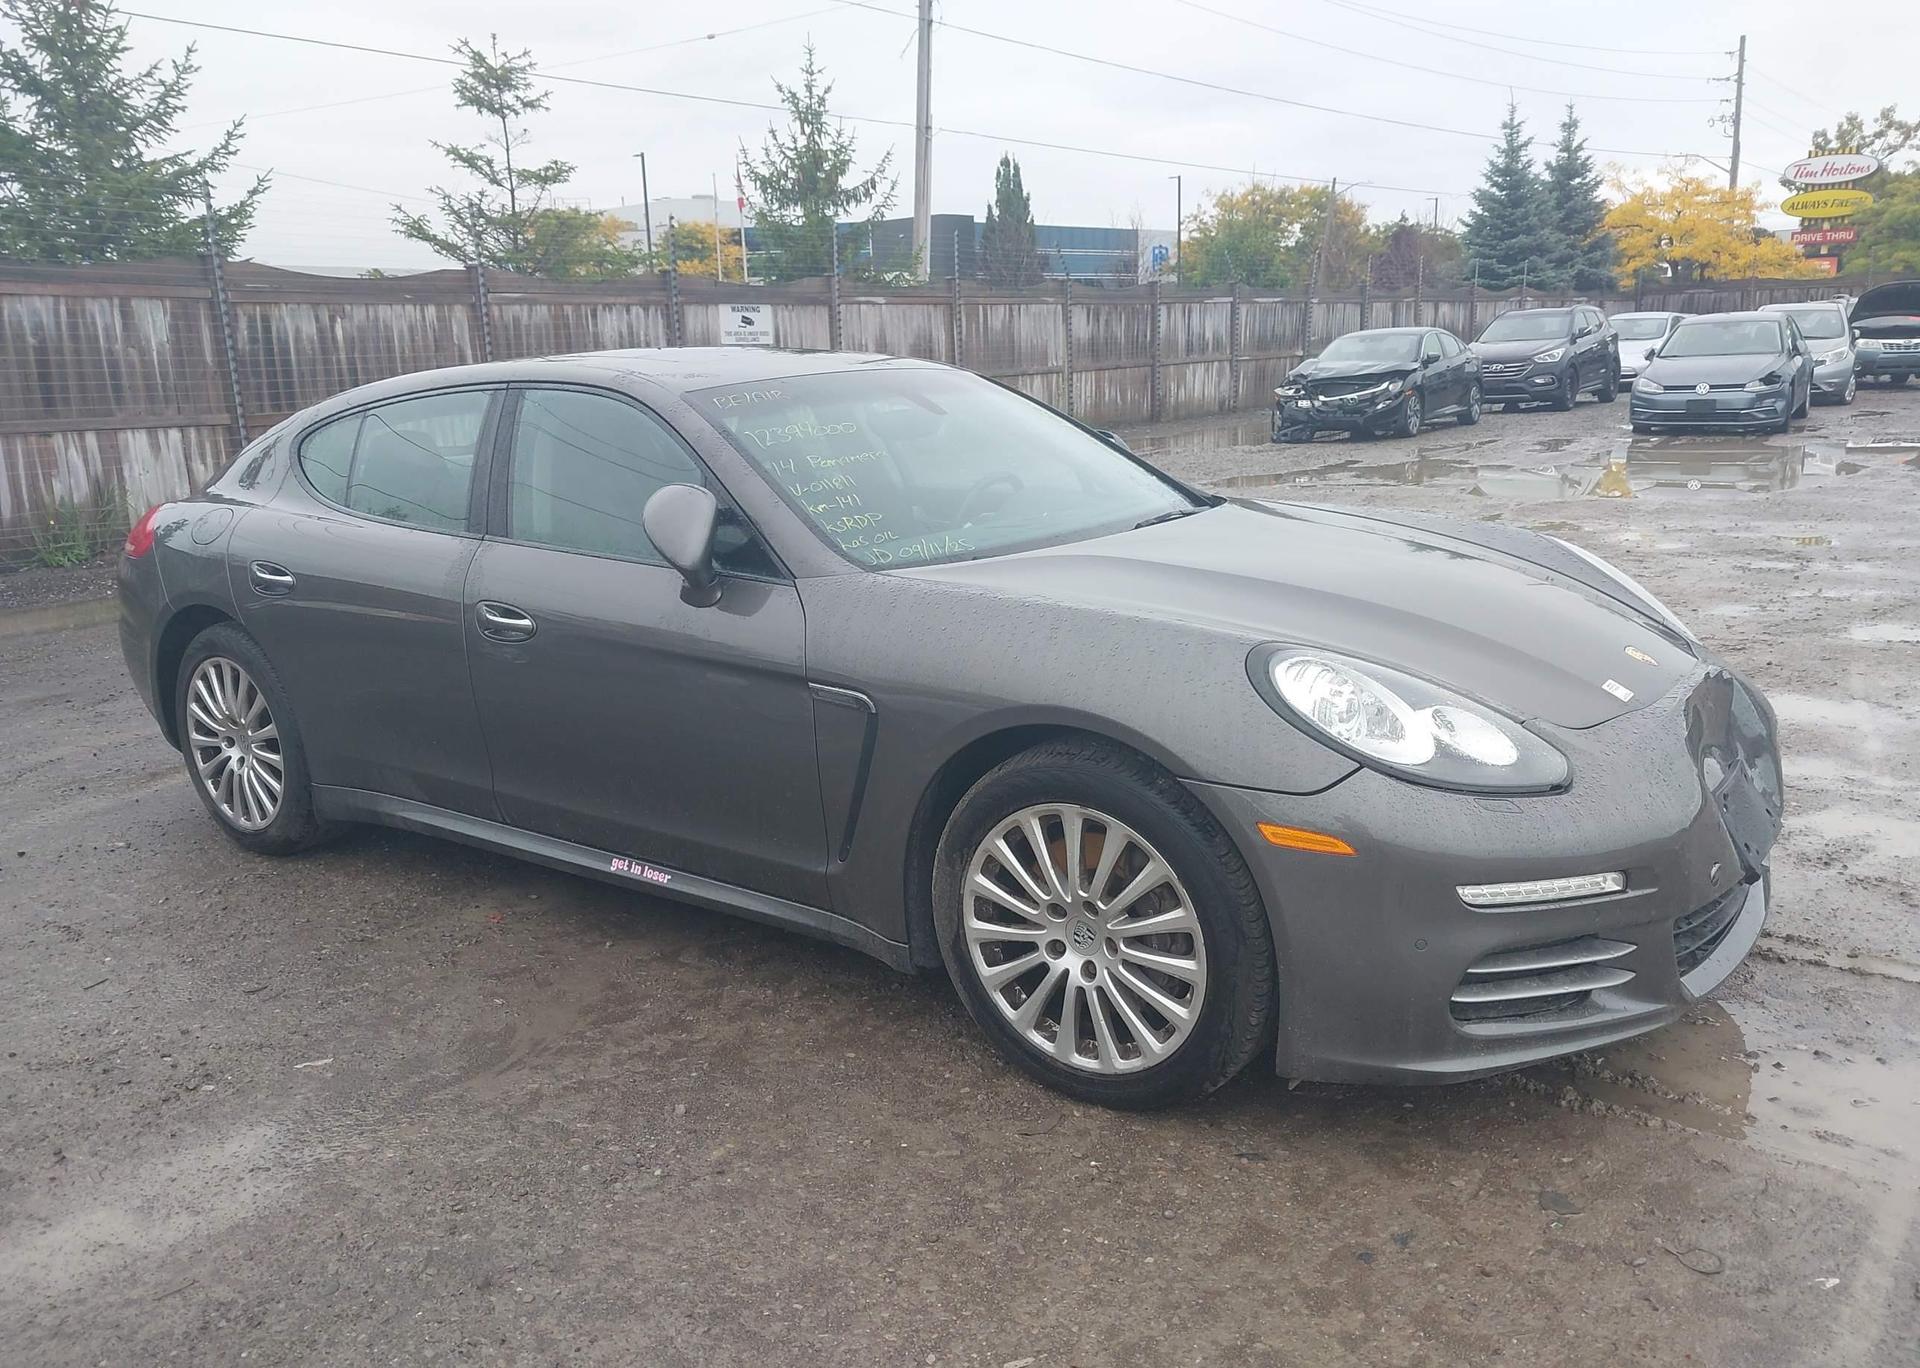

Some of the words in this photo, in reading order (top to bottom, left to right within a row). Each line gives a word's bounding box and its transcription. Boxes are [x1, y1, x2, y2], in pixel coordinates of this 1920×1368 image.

[1793, 163, 1819, 180] Tim
[1820, 161, 1872, 179] Hortons
[1787, 199, 1828, 211] ALWAYS
[1793, 232, 1823, 242] DRIVE
[1826, 231, 1854, 241] THRU
[730, 305, 761, 313] WARNING
[610, 858, 629, 871] get
[630, 861, 642, 875] in
[643, 865, 672, 883] loser
